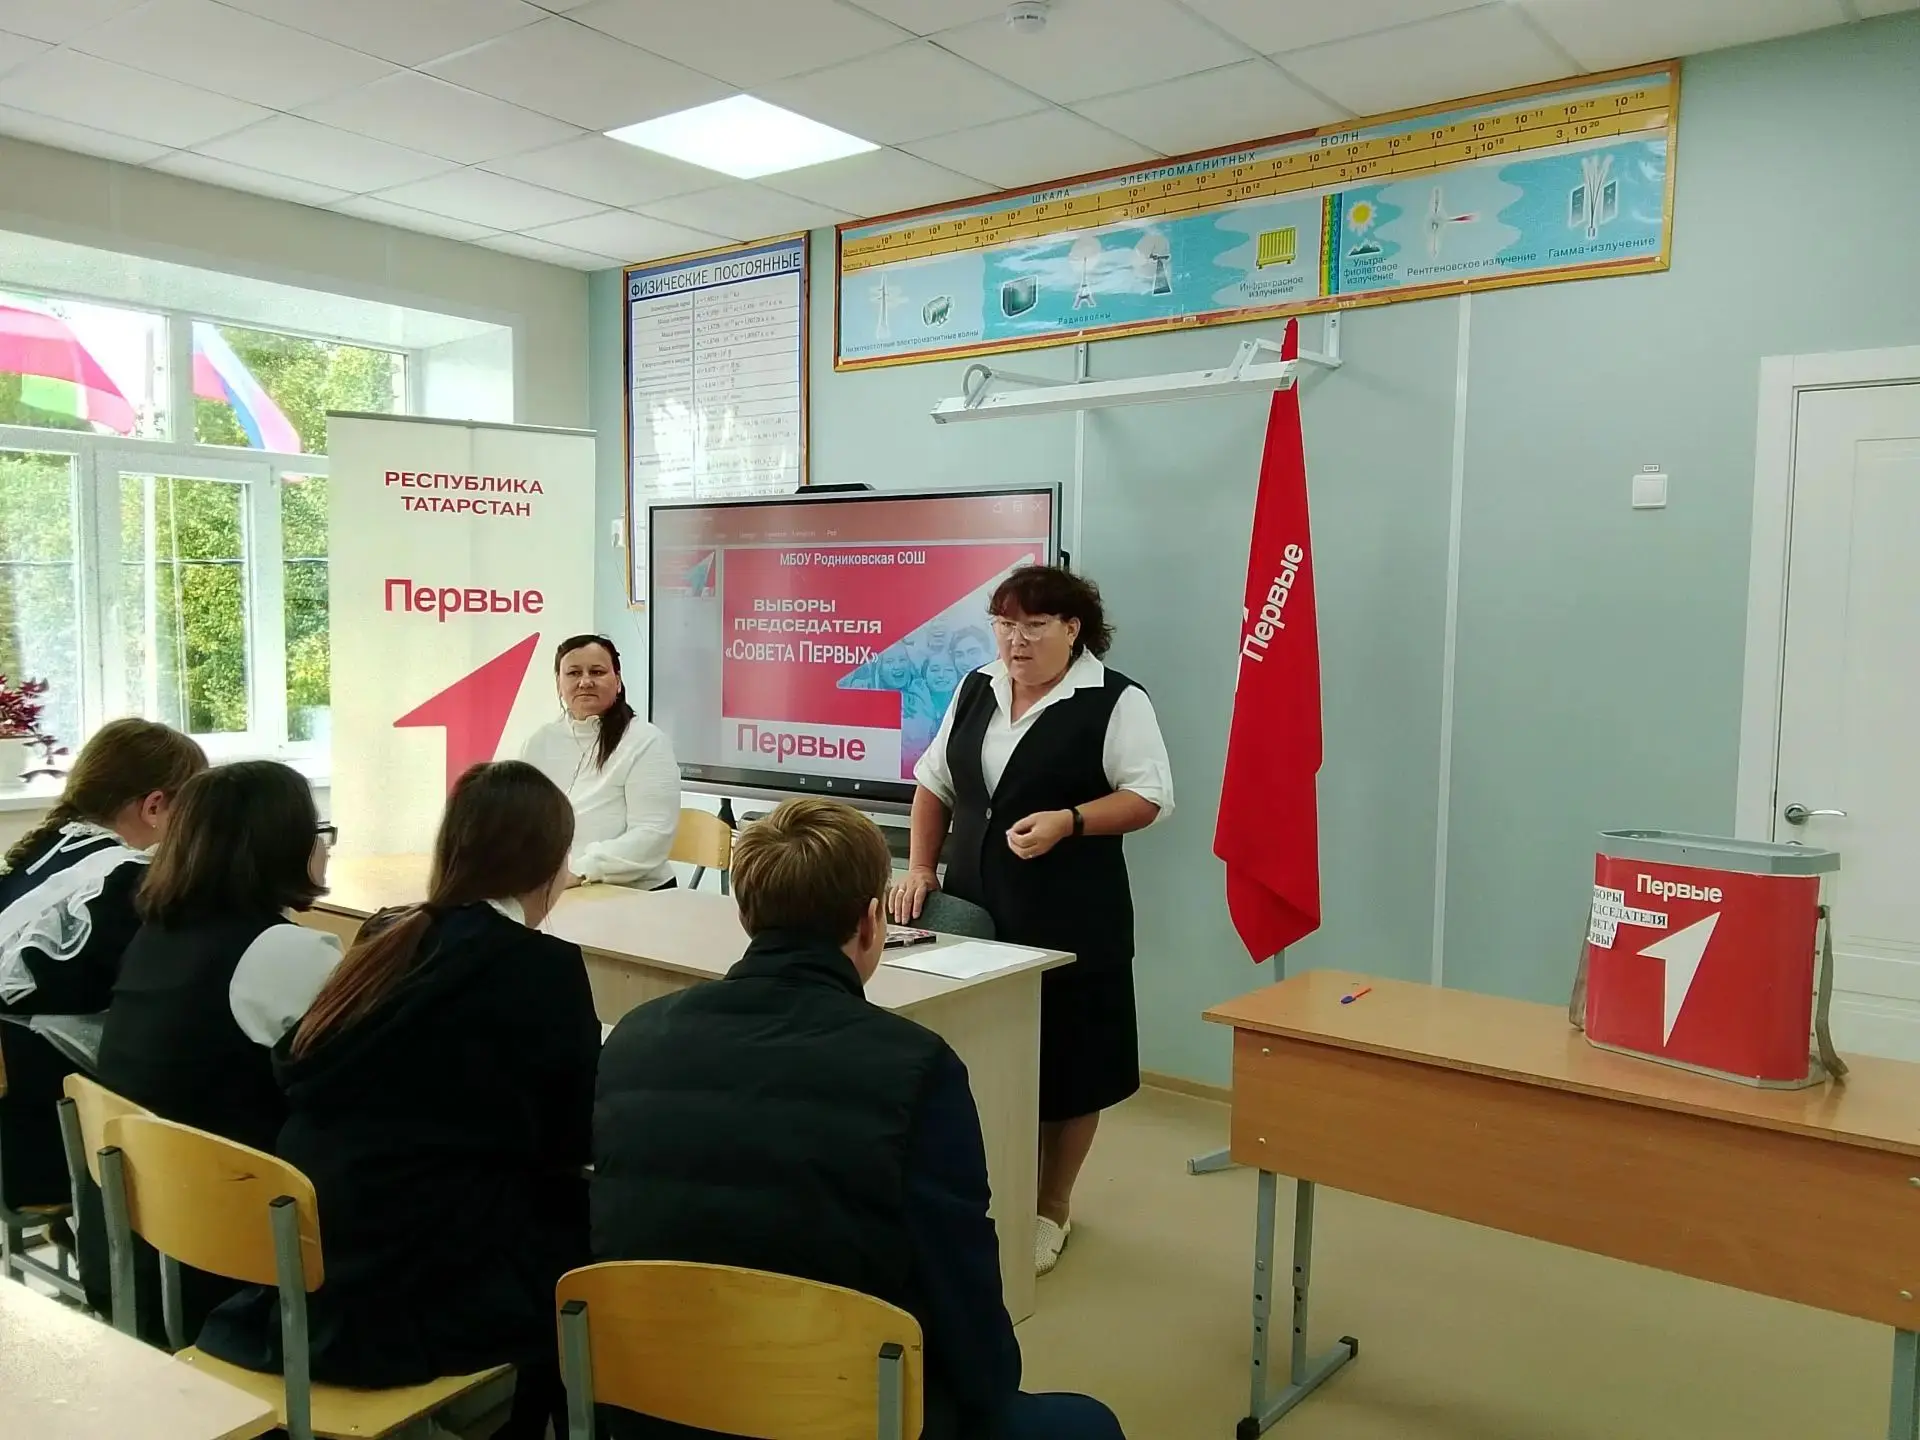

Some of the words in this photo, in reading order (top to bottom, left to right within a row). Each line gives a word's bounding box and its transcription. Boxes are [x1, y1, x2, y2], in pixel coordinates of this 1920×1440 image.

[1032, 189, 1070, 204] ШКАЛА
[1120, 152, 1256, 186] ЭЛЕКТРОМАГНИТНЫХ
[1320, 131, 1359, 147] ВОЛН
[1548, 237, 1656, 259] Гамма-излучение
[1344, 263, 1398, 278] фиолетовое
[1353, 256, 1387, 268] Ультра-
[1407, 259, 1480, 277] Рентгеновское
[1482, 252, 1537, 269] излучение
[631, 269, 708, 297] ФИЗИЧЕСКИЕ
[714, 252, 801, 282] ПОСТОЯННЫЕ
[1347, 272, 1394, 285] излучение
[1249, 285, 1295, 298] излучение
[385, 471, 544, 495] РЕСПУБЛИКА
[401, 496, 531, 517] ТАТАРСТАН
[780, 553, 812, 566] МБОУ
[814, 553, 895, 567] Родниковская
[897, 551, 926, 565] СОШ
[385, 578, 544, 623] Первые
[754, 599, 836, 613] ВЫБОРЫ
[1243, 543, 1304, 662] Первые
[734, 617, 882, 635] ПРЕДСЕДАТЕЛЯ
[737, 723, 866, 764] Первые
[1637, 874, 1723, 903] Первые
